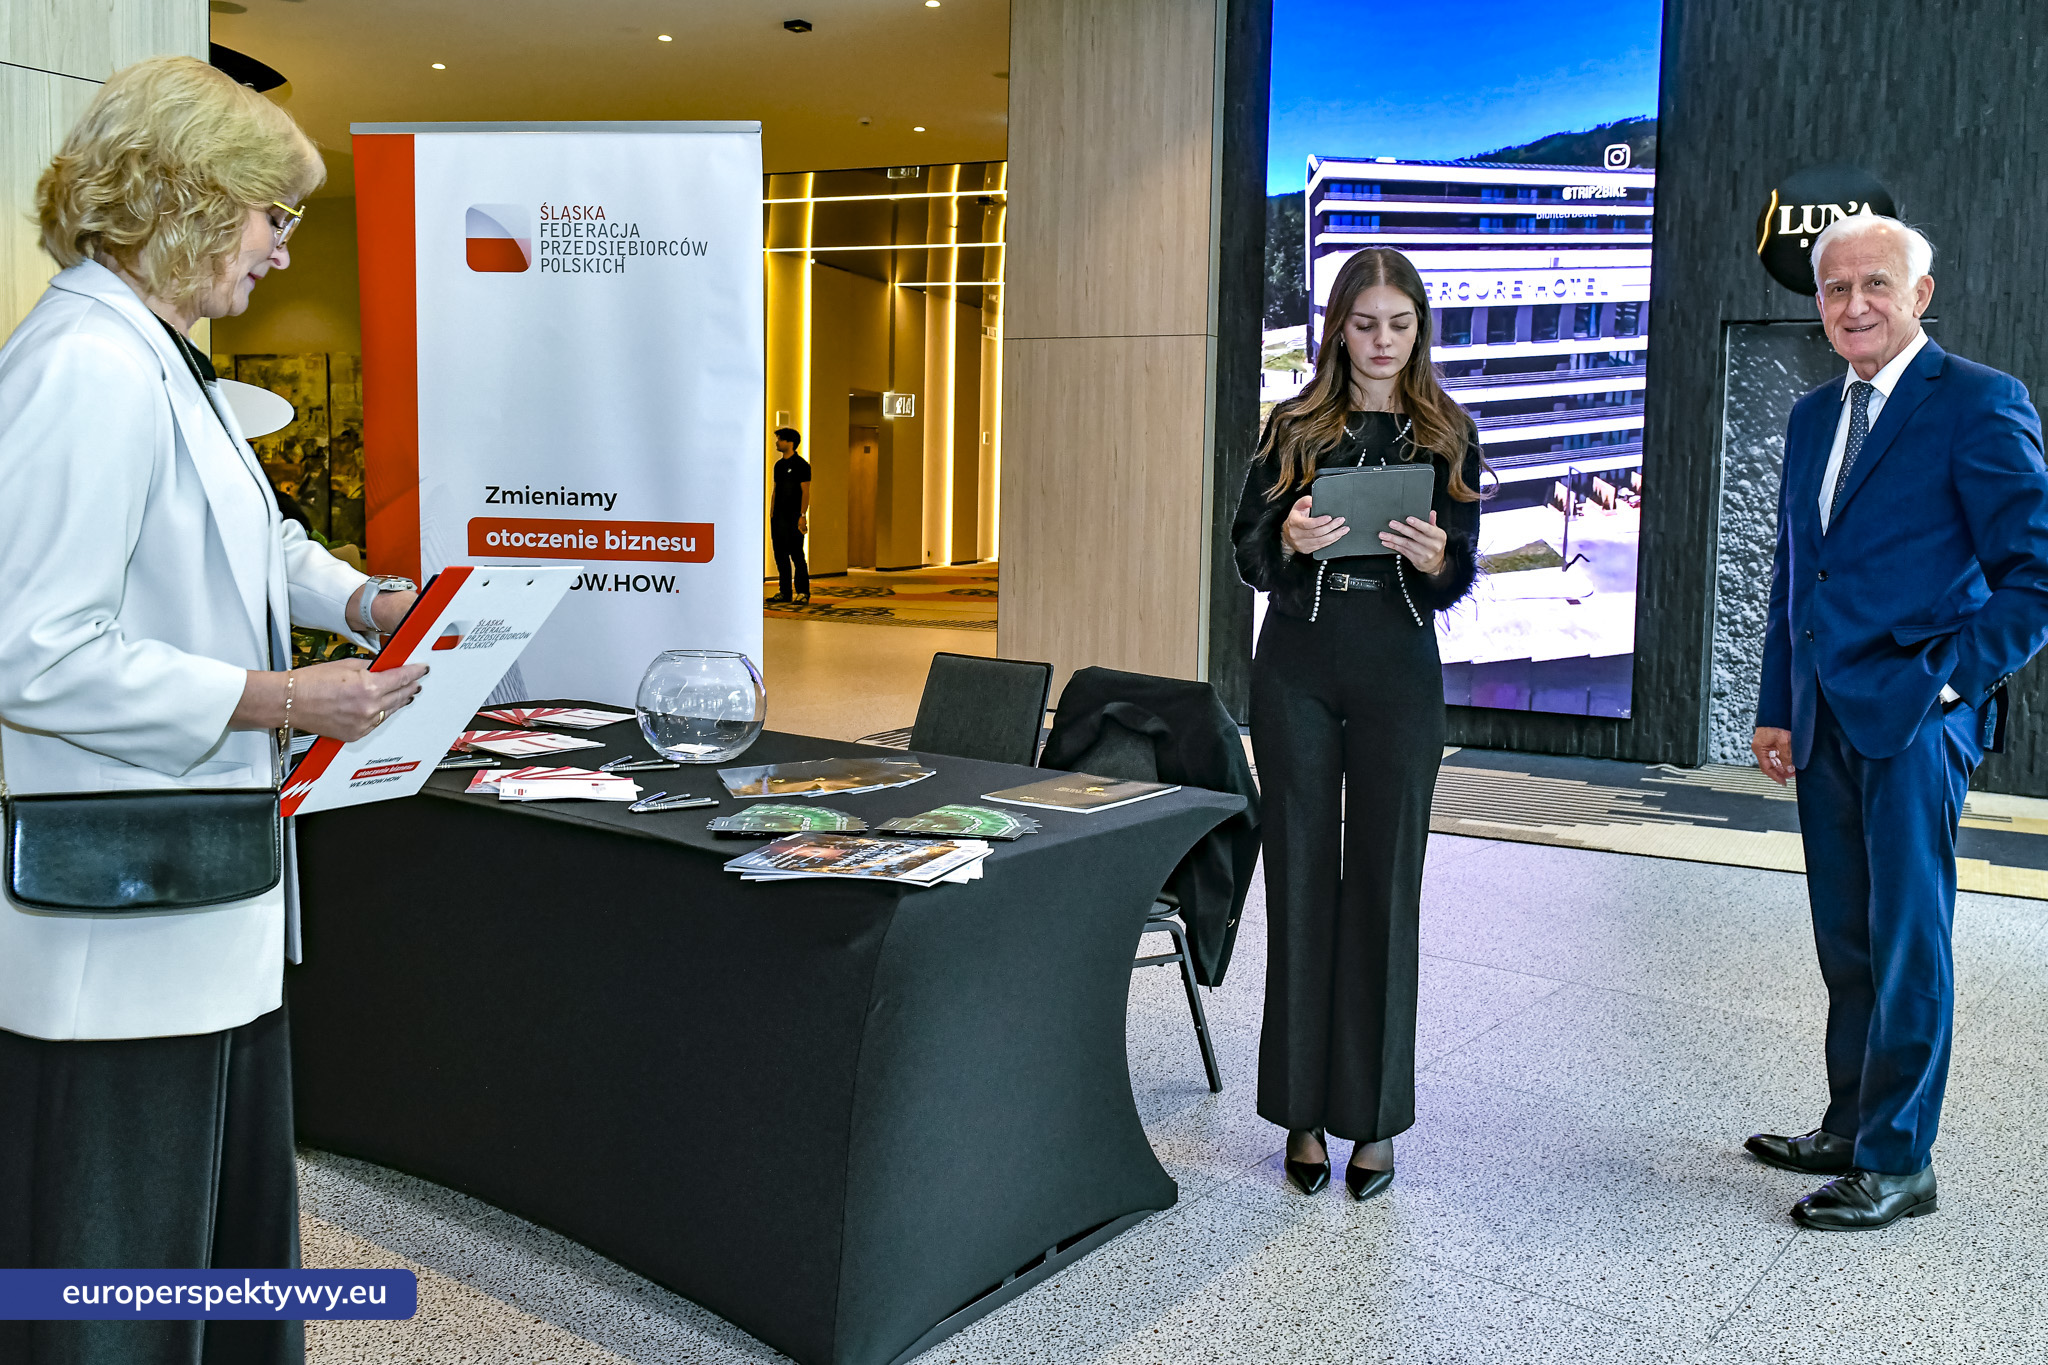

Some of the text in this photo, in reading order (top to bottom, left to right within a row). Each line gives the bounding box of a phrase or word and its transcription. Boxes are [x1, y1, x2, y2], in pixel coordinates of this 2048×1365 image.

[1562, 185, 1627, 200] @TRIP2BIKE
[540, 202, 606, 223] ŚLĄSKA
[540, 222, 641, 238] FEDERACJA
[540, 237, 709, 259] PRZEDSIĘBIORCÓW
[541, 257, 625, 273] POLSKICH
[1423, 278, 1609, 301] ERCURE HOTEL
[485, 485, 618, 511] Zmieniamy
[486, 528, 697, 552] otoczenie biznesu
[569, 573, 680, 594] OW.HOW.
[470, 625, 513, 634] FEDERACJA
[459, 640, 497, 650] POLSKICH
